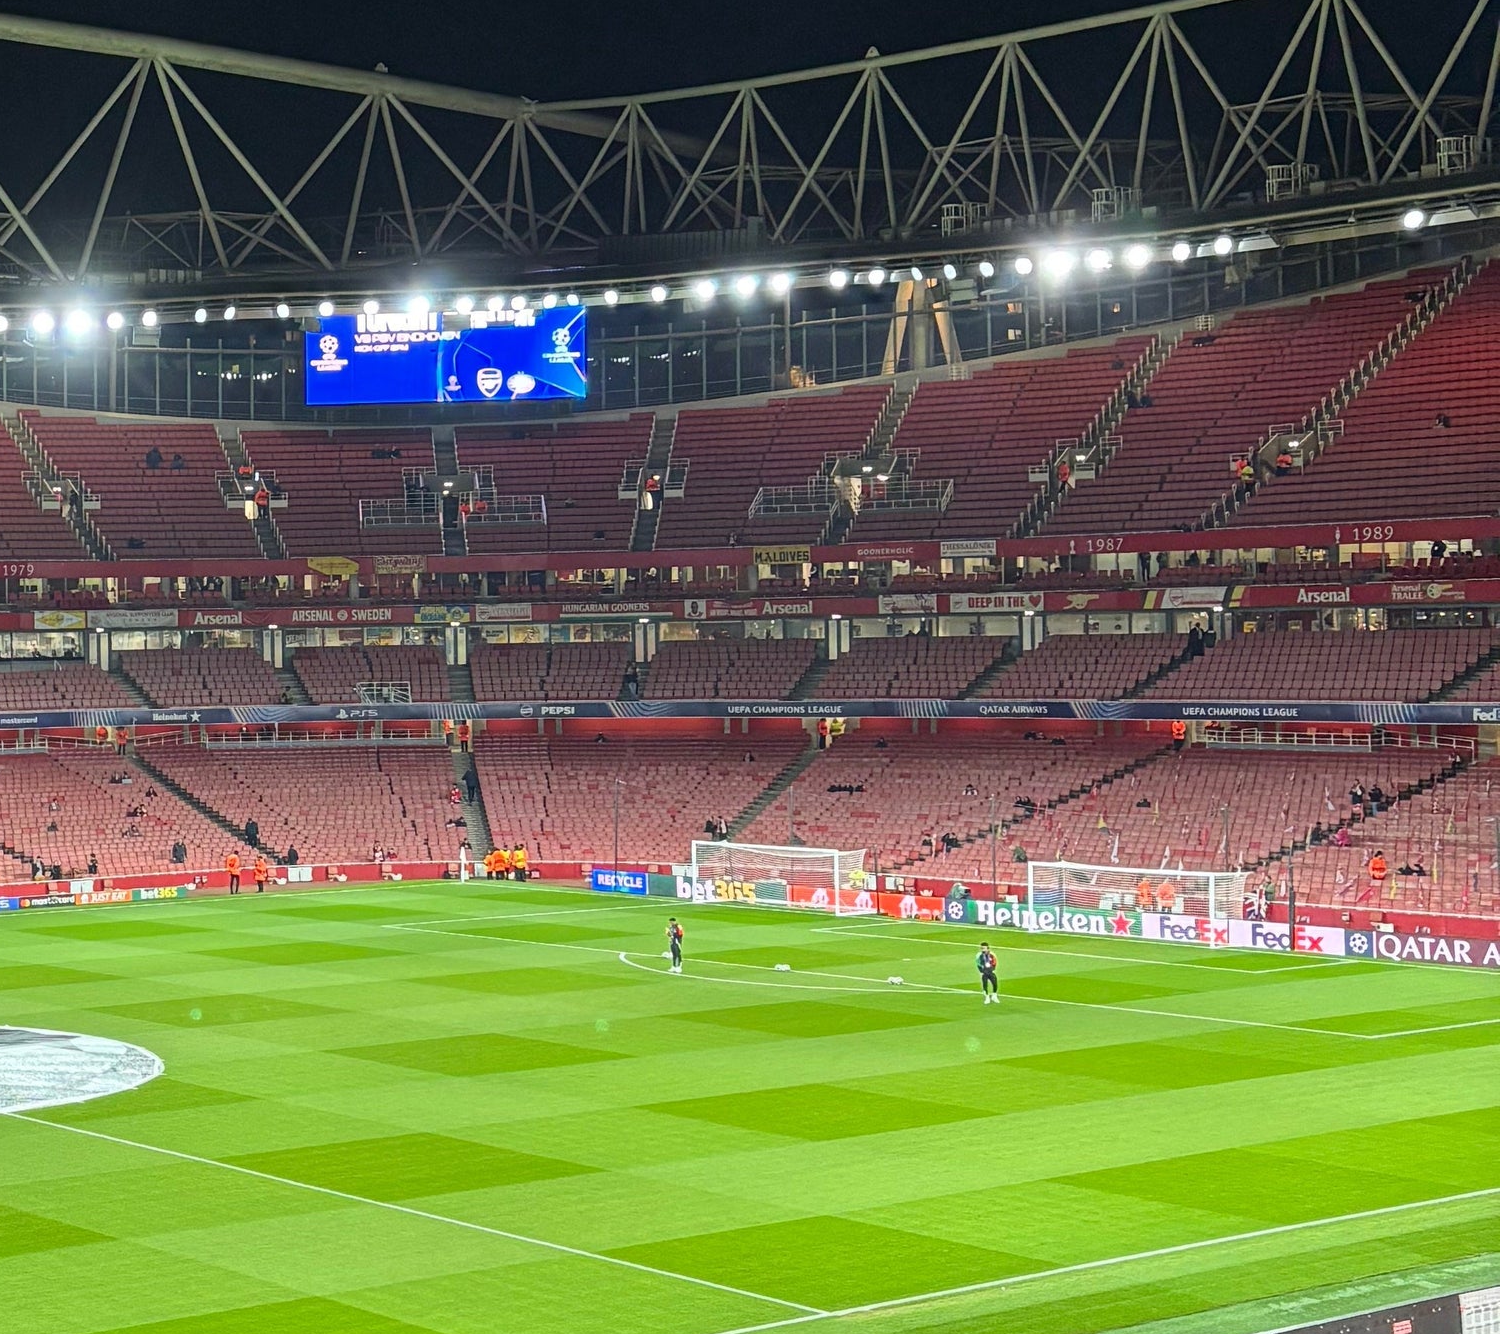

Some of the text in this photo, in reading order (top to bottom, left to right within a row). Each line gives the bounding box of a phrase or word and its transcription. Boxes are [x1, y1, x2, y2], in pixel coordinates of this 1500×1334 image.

[1353, 526, 1394, 541] 1989
[857, 546, 914, 556] GOONERHOLIC
[1087, 538, 1124, 552] 1987
[754, 550, 809, 563] MALDIVES
[2, 564, 35, 576] 1979
[1297, 587, 1349, 603] Arsenal
[562, 602, 649, 613] HUNGARIAN GOONERS
[762, 601, 812, 615] Arsenal
[968, 597, 992, 608] DEEP
[1007, 596, 1025, 607] THE
[194, 612, 242, 625] Arsenal
[292, 608, 392, 622] ARSENAL SWEDEN
[350, 709, 378, 717] PS5
[541, 706, 575, 715] PEPSI
[727, 705, 842, 714] UEFA CHAMPIONS LEAGUE
[979, 705, 1048, 714] QATAR AIRWAYS
[1182, 707, 1298, 717] UEFA CHAMPIONS LEAGUE
[0, 716, 38, 724] mastercard
[152, 712, 188, 721] Heineken
[598, 874, 643, 888] RECYCLE
[140, 887, 178, 899] bet365
[677, 877, 756, 901] bet365
[31, 895, 75, 905] mastercard
[91, 891, 127, 902] JUST EAT
[977, 900, 1107, 935] Heineken
[1160, 916, 1229, 943] FedEx
[1251, 923, 1324, 952] FedEx
[1378, 934, 1473, 964] QATAR
